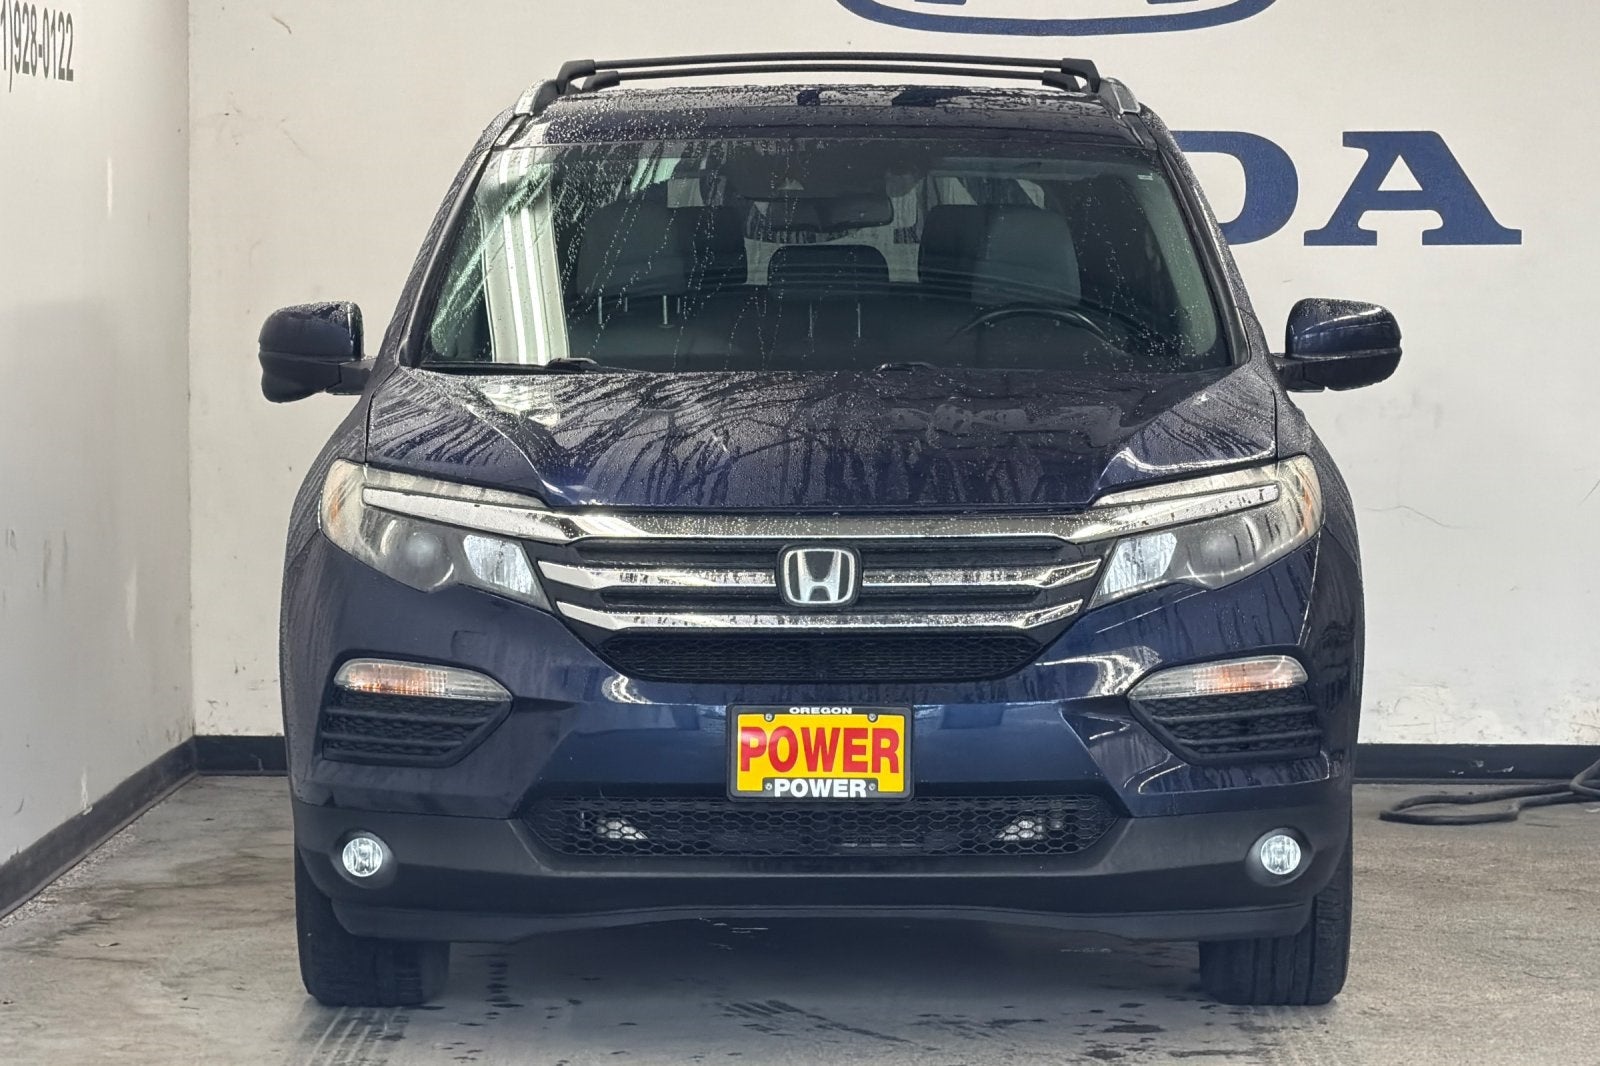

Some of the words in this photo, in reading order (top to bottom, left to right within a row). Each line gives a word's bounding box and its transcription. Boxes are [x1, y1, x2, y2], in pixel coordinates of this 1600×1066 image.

[788, 706, 853, 715] OREGON
[740, 725, 900, 774] POWER
[774, 778, 867, 798] POWER
